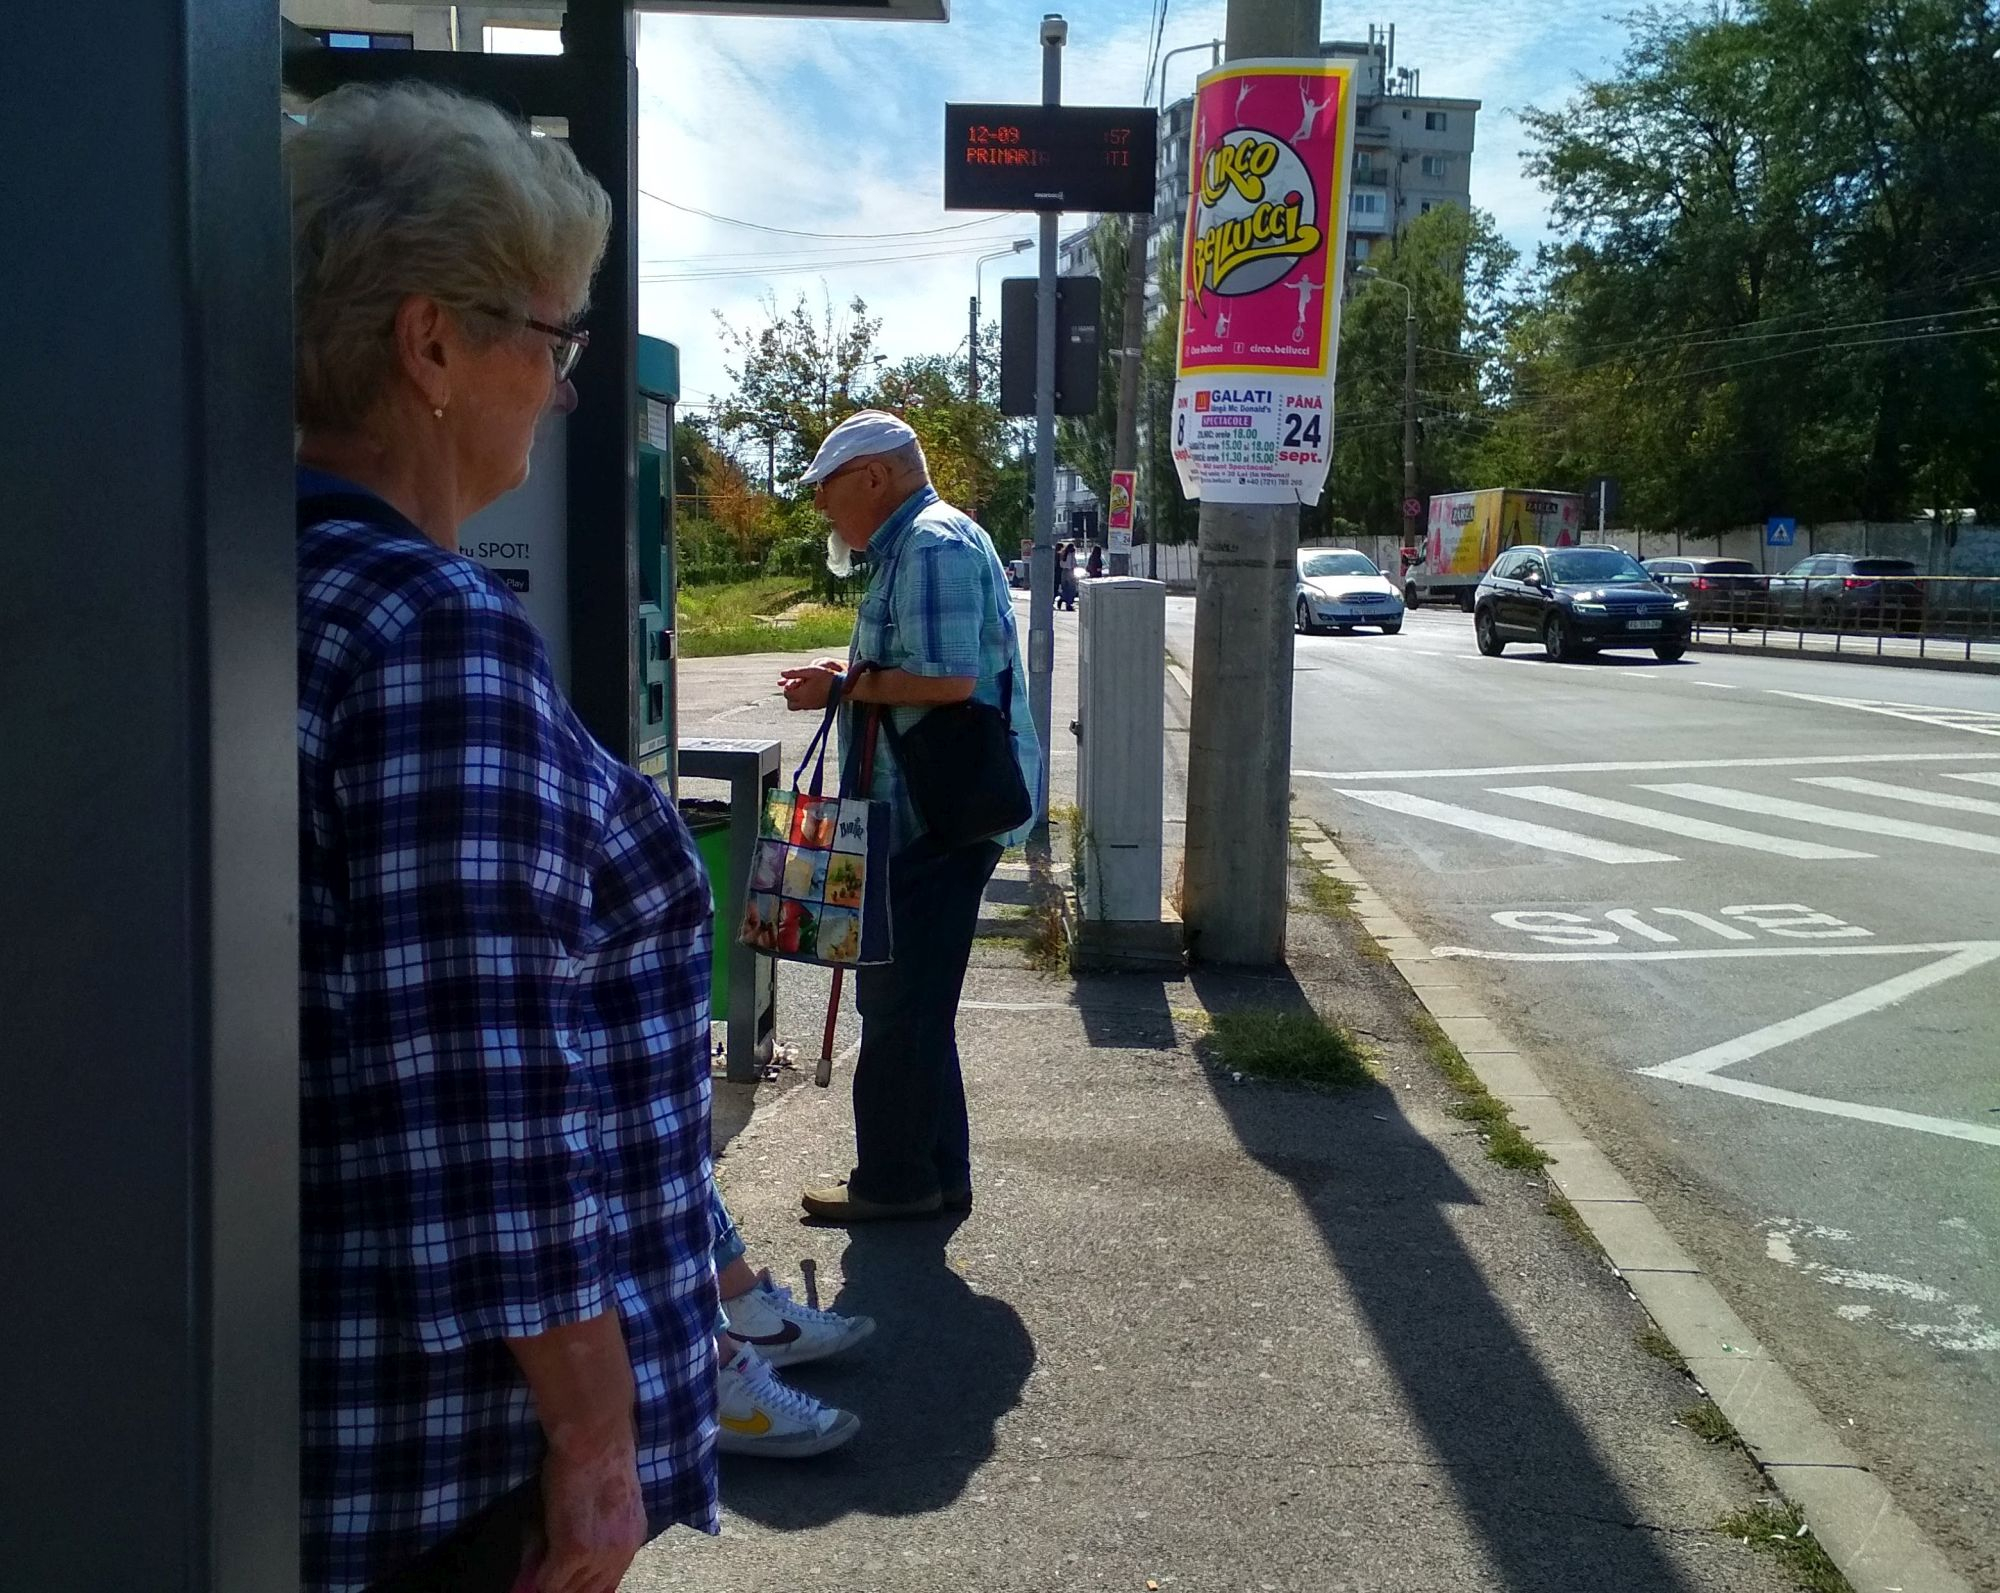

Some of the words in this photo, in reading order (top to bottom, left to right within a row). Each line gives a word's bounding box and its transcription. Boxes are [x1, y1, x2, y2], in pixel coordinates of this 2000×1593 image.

[1212, 390, 1272, 403] GALATI
[1203, 416, 1249, 426] SPECTACOLE
[1233, 428, 1258, 439] 18.00
[1283, 413, 1322, 448] 24
[1221, 440, 1242, 450] 15.00
[1251, 441, 1275, 451] 18.00
[1221, 452, 1242, 462] 11.30
[1251, 453, 1274, 463] 15.00
[478, 542, 530, 559] SPOT!
[1490, 903, 1875, 946] BUS
